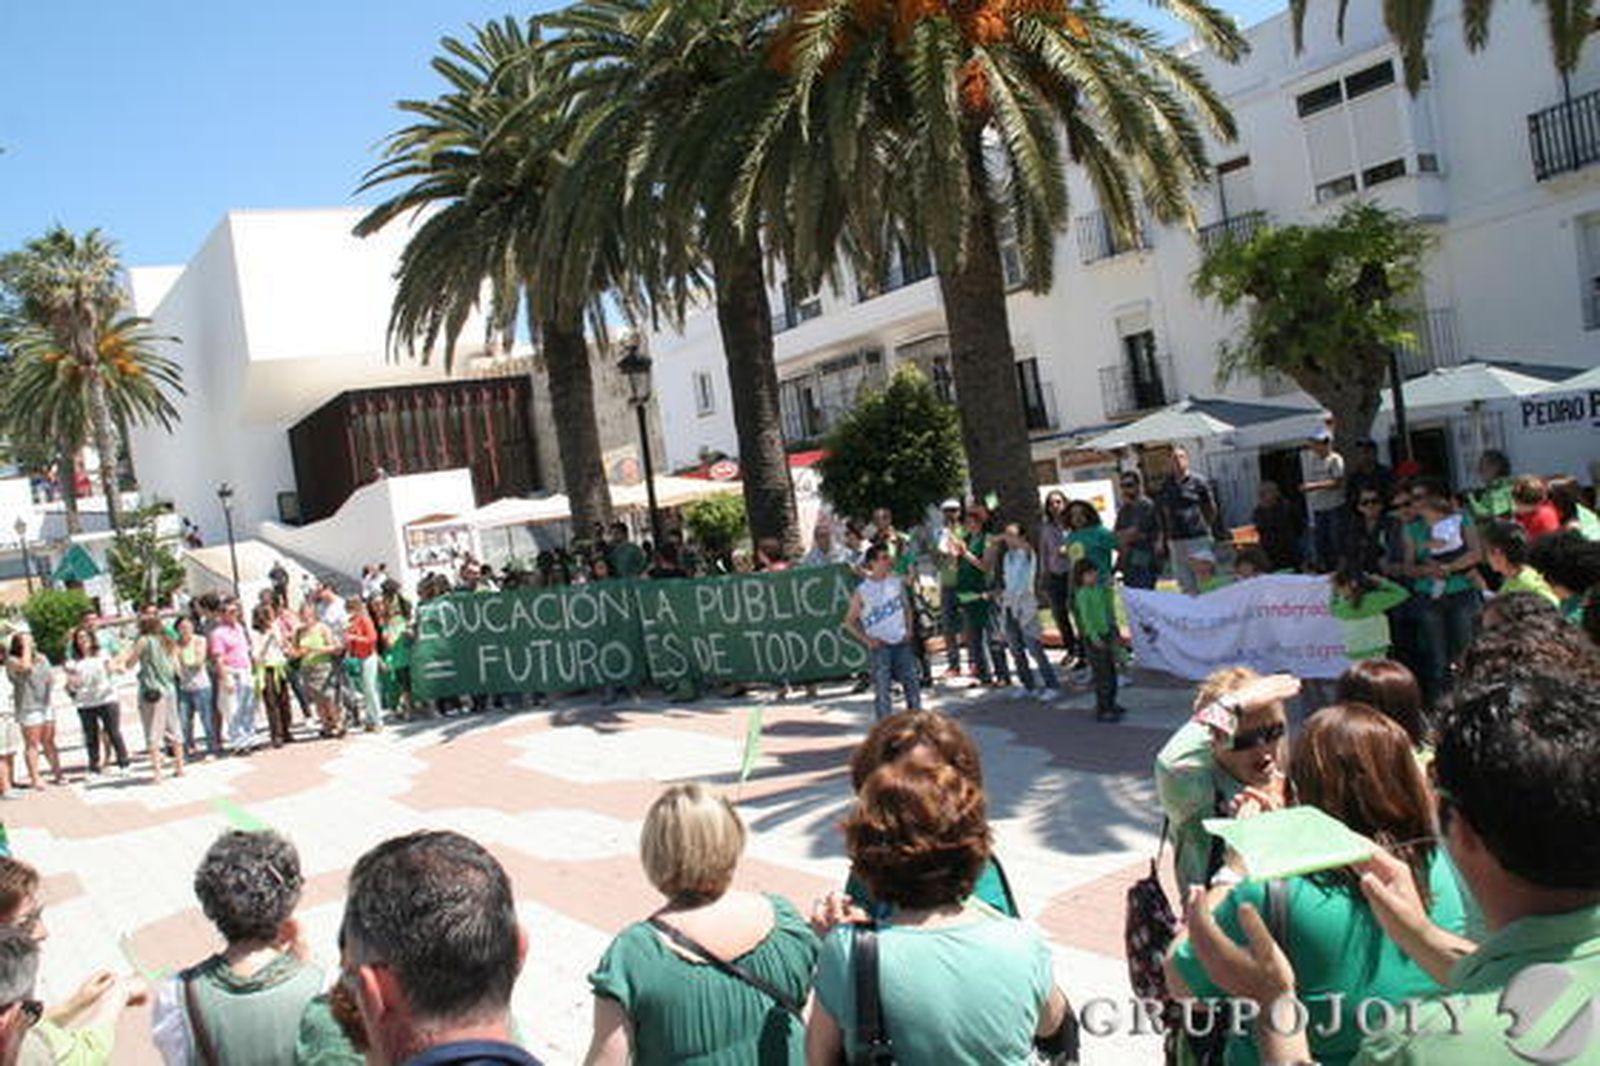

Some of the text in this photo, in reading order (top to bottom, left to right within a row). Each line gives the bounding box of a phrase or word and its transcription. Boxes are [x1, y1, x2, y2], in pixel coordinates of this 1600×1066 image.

[1521, 396, 1585, 429] PEDRO
[417, 584, 630, 640] EDUCACIÓN
[634, 587, 679, 627] LA
[478, 638, 634, 685] FUTURO
[644, 624, 867, 678] ES DE TODOS
